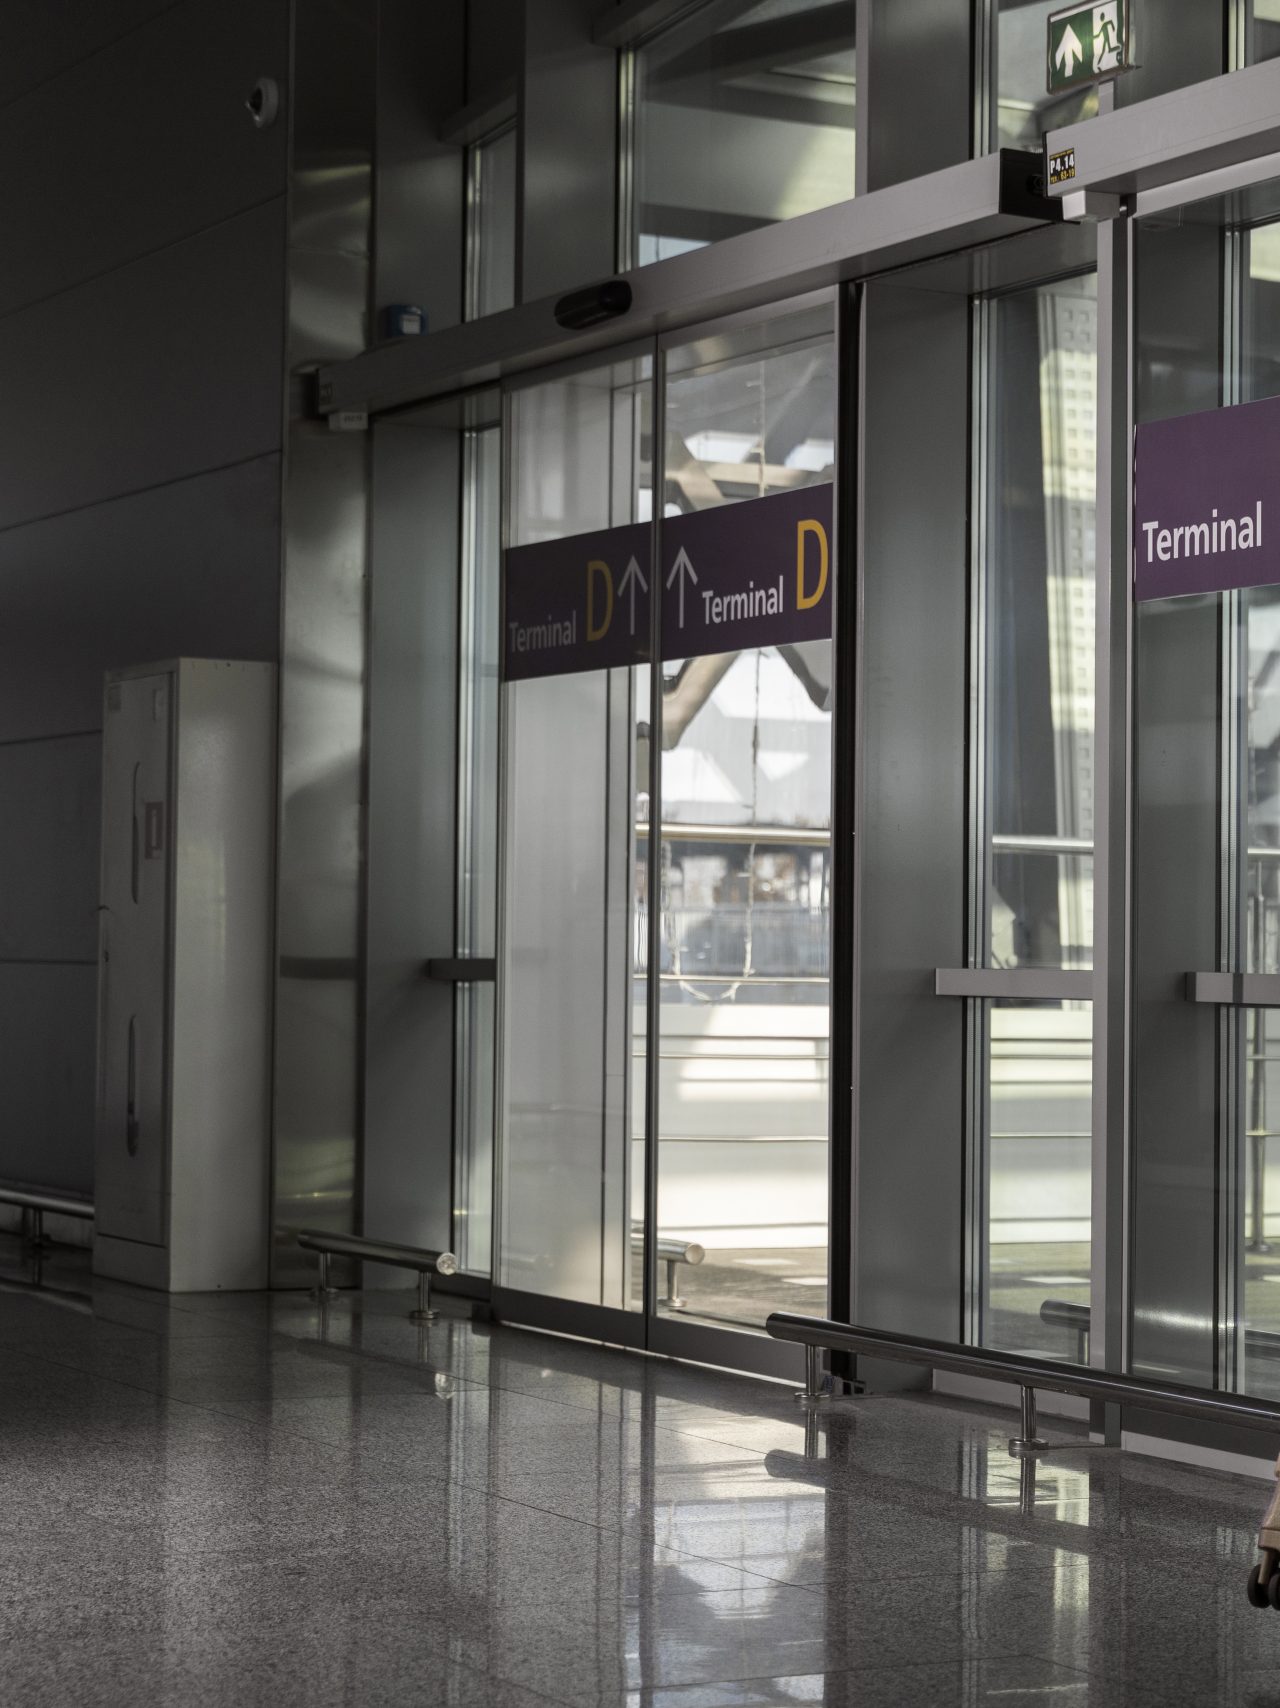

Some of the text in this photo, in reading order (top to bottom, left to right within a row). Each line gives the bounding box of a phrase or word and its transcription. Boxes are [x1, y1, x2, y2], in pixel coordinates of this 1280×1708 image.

[1050, 153, 1075, 174] P4.14
[1142, 501, 1262, 562] Terminal
[509, 560, 614, 652] Terminal D
[702, 519, 829, 625] Terminal D
